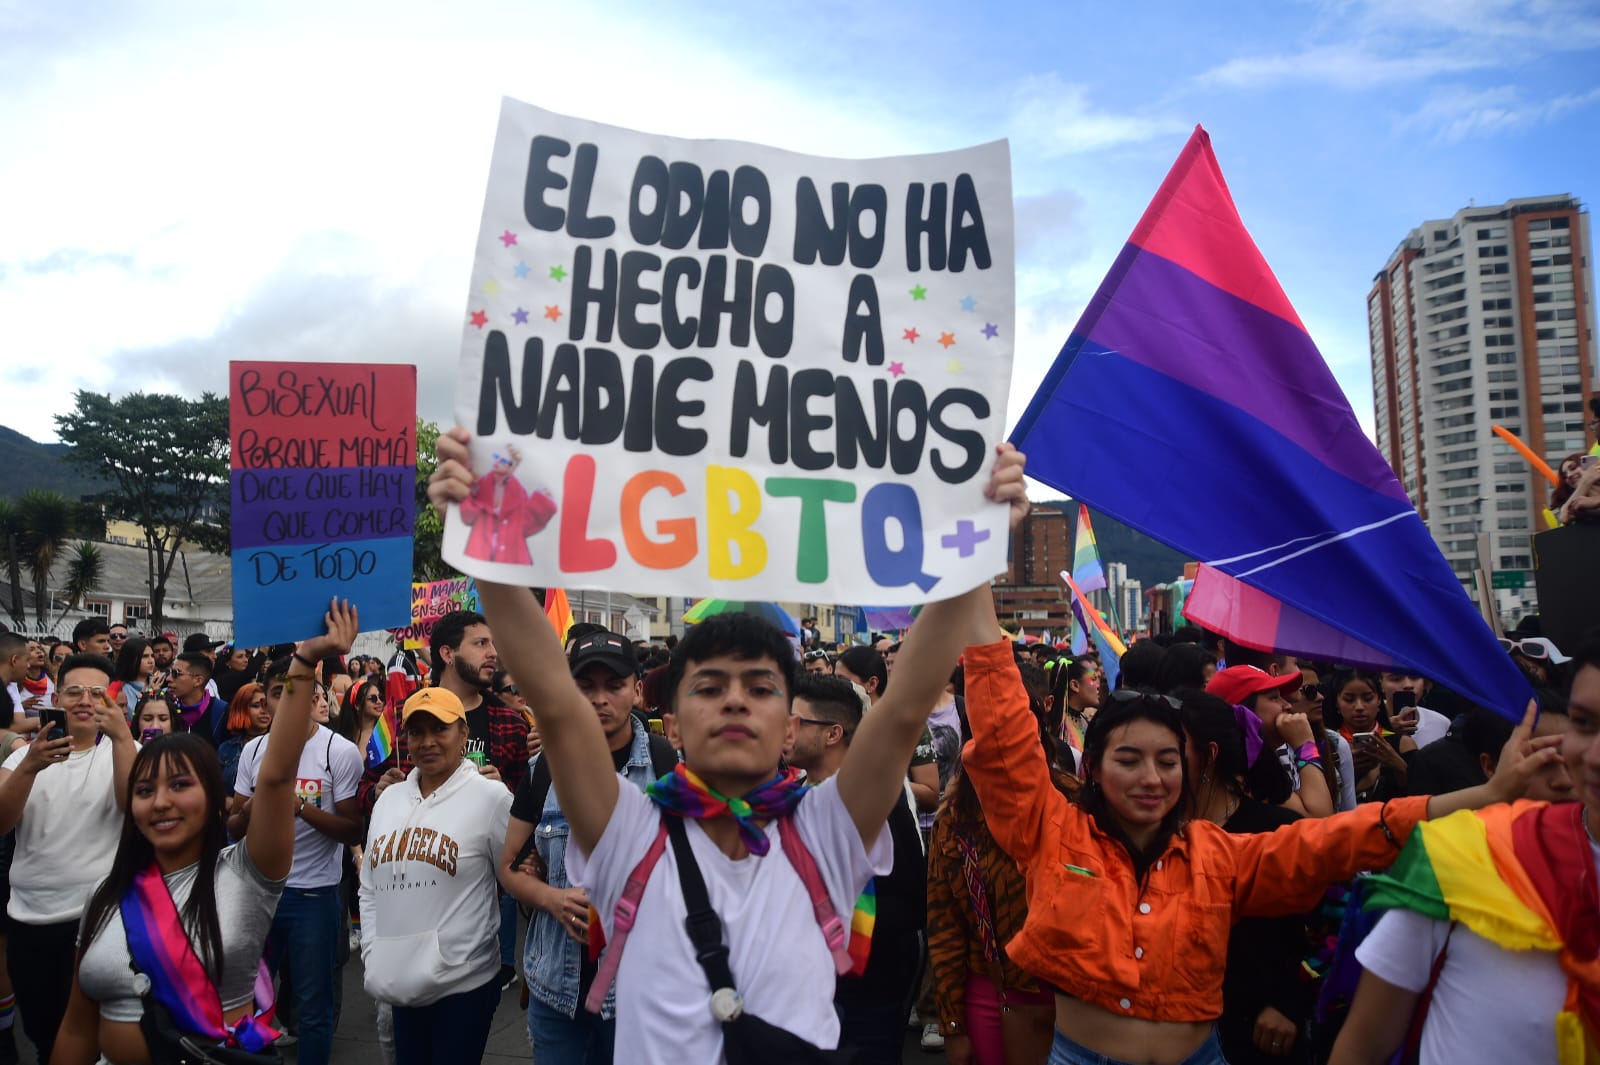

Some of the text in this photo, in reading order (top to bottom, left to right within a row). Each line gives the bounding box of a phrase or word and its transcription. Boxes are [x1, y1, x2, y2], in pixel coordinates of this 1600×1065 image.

[524, 135, 992, 273] EL ODIO NO HA
[568, 245, 885, 366] HECHO A
[476, 330, 991, 484] NADIE MENOS
[238, 427, 409, 469] PORQUE MAMÁ
[305, 472, 352, 501] QUE
[359, 469, 403, 504] HAY
[262, 507, 409, 543] QUE COMER
[249, 543, 376, 586] DE TODO
[412, 587, 427, 603] MI
[467, 596, 476, 611] A
[395, 621, 435, 641] COME
[381, 827, 459, 878] ANGELES
